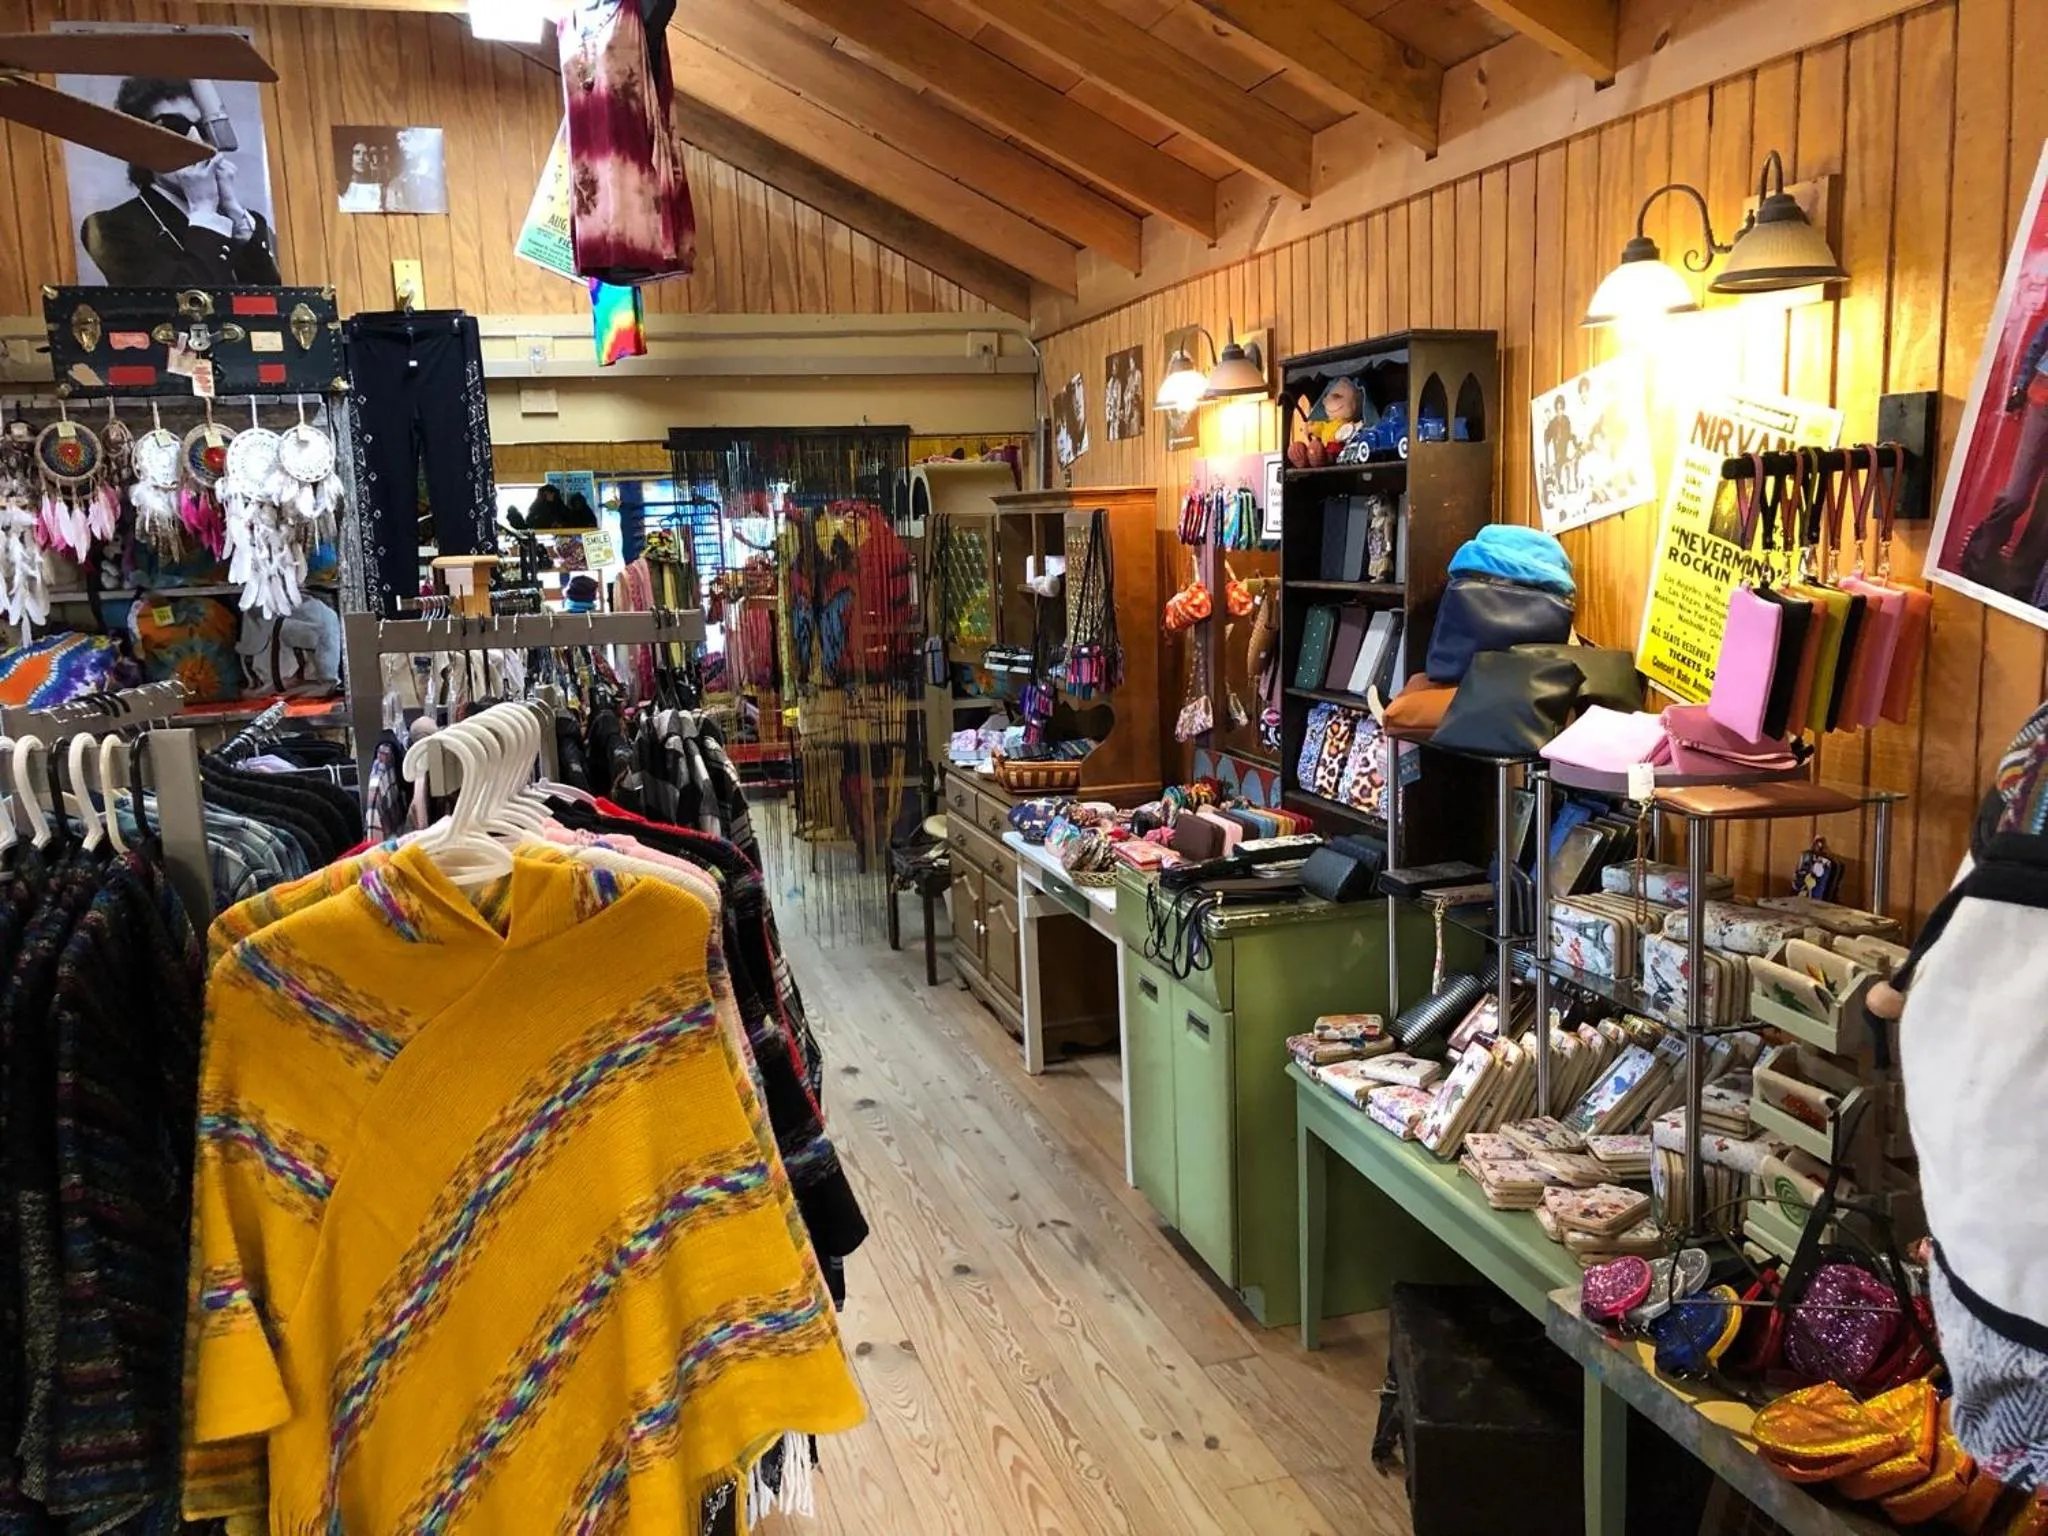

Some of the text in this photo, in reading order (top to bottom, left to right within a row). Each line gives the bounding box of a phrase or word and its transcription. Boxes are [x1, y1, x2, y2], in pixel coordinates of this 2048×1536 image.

[1690, 410, 1796, 457] NIRVAN
[1676, 502, 1699, 518] Spirit
[586, 534, 609, 546] SMILE
[1663, 630, 1681, 647] SEATS
[1669, 648, 1716, 681] TICKETS $2
